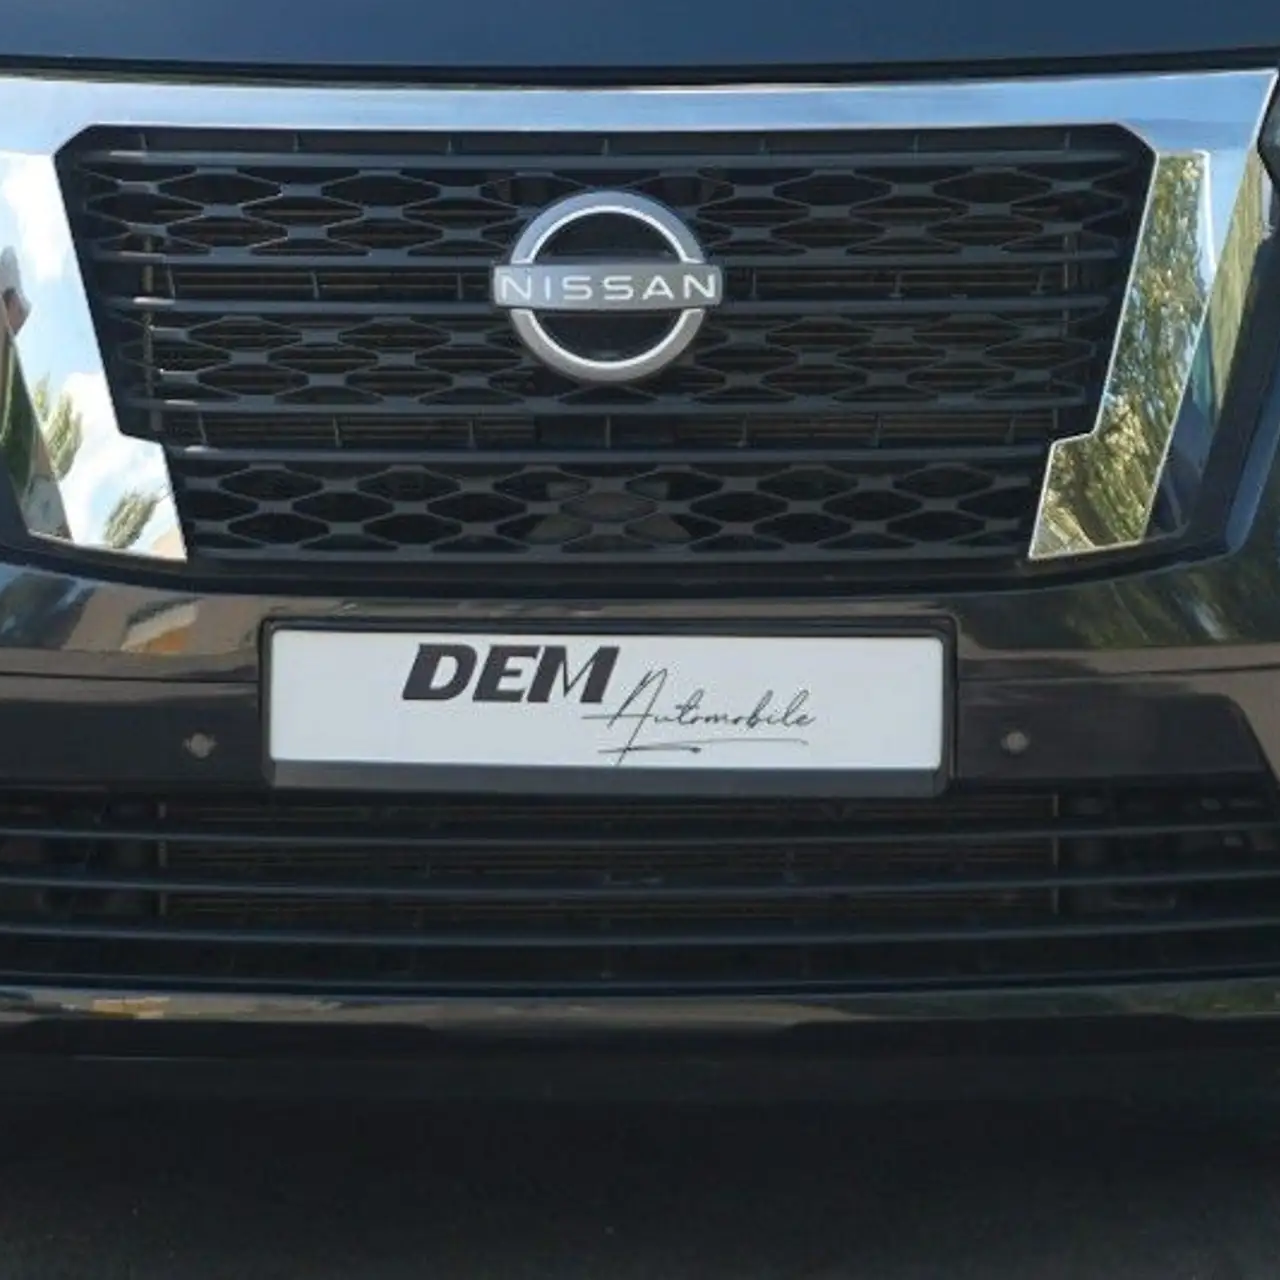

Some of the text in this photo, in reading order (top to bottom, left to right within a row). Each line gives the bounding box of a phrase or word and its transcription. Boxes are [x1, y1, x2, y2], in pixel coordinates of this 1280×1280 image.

[500, 274, 716, 300] NISSAN
[402, 644, 816, 766] DEM Automobile
